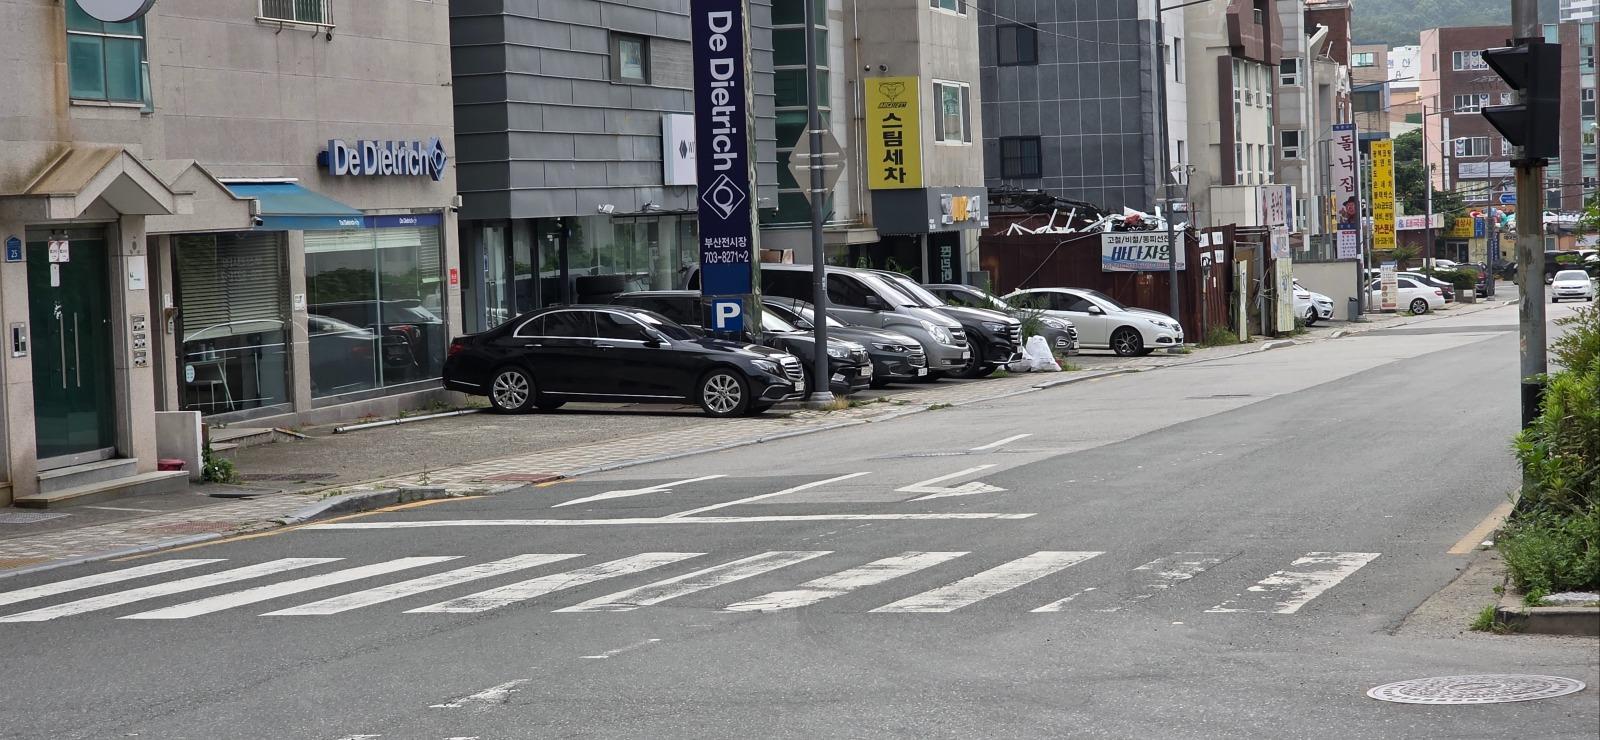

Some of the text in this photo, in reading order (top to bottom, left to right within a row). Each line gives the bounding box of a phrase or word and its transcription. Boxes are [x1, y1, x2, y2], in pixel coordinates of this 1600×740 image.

[707, 11, 738, 171] De Dietrich
[333, 140, 431, 176] De Dietrich
[881, 112, 907, 184] 스팀세차
[1337, 134, 1355, 194] 돌낙집
[704, 236, 748, 249] 부산전시장
[704, 250, 749, 263] 703-8271~2
[716, 302, 741, 328] P
